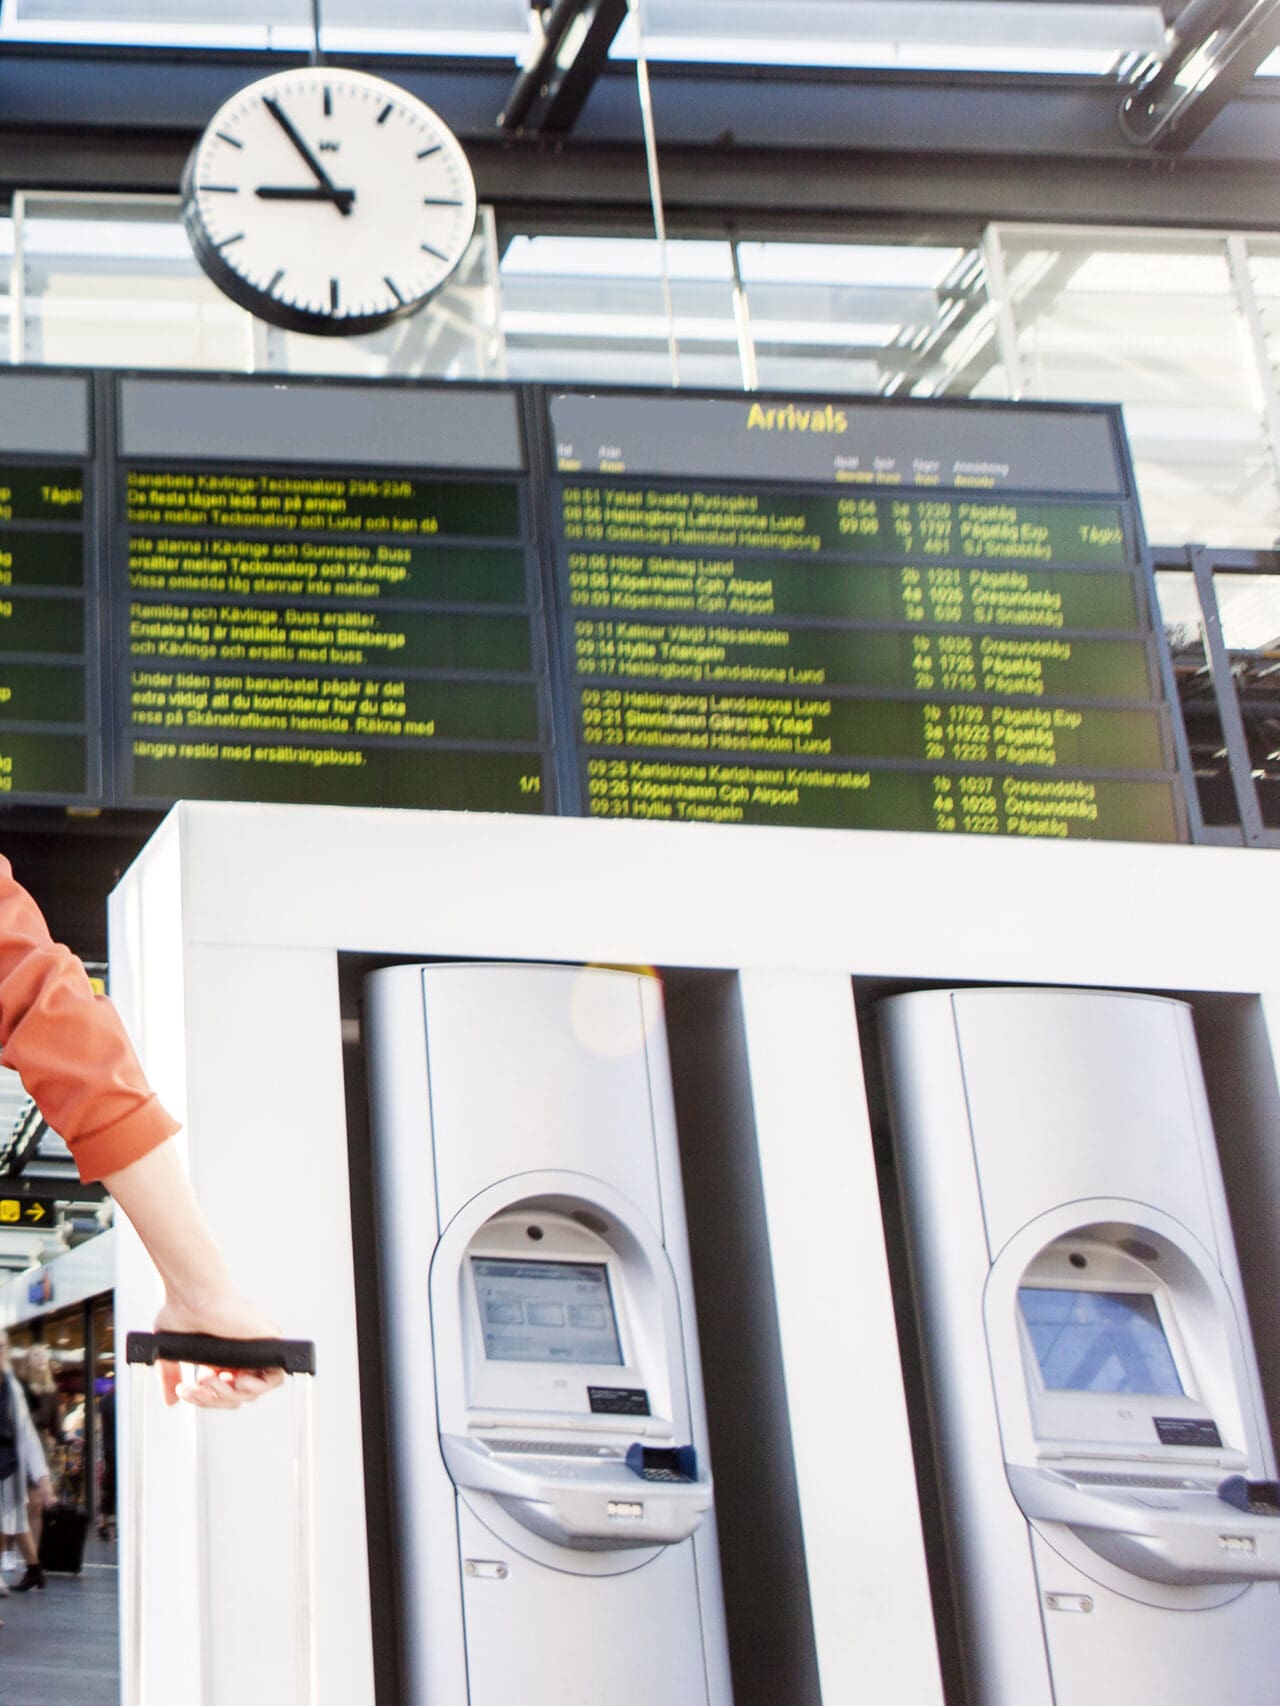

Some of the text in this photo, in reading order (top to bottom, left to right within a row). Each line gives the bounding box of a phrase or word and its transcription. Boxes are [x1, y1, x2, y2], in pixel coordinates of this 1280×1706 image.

[746, 403, 849, 434] Arrivals
[189, 491, 227, 511] tågen
[261, 496, 281, 510] om
[284, 494, 302, 514] på
[305, 498, 347, 512] annan
[165, 509, 208, 526] mellan
[301, 514, 325, 530] och
[328, 515, 362, 532] Lund
[365, 516, 390, 533] och
[393, 517, 418, 534] kan
[769, 513, 1019, 541] Lund Pågatåg
[157, 537, 201, 555] stanna
[213, 540, 270, 561] Kävlinge
[273, 542, 298, 558] och
[377, 546, 412, 563] Buss
[130, 556, 180, 573] ersätter
[183, 557, 227, 575] mellan
[321, 562, 345, 579] och
[698, 559, 1028, 589] Lund Pågatåg
[228, 576, 250, 596] tåg
[254, 577, 305, 594] stannar
[308, 579, 332, 596] inte
[335, 580, 380, 597] mellan
[610, 572, 1062, 608] Köpenhamn Cph Airport Öresundståg
[192, 605, 217, 622] och
[285, 608, 320, 626] Buss
[696, 594, 727, 614] Cph
[728, 596, 775, 616] Airport
[187, 623, 210, 644] tåg
[213, 624, 228, 641] är
[231, 625, 287, 643] inställda
[290, 627, 334, 645] mellan
[337, 629, 406, 650] Billeberga
[980, 637, 1072, 659] Öresundståg
[131, 640, 156, 656] och
[159, 642, 217, 662] Kävlinge
[221, 644, 246, 660] och
[298, 647, 327, 662] med
[618, 640, 1042, 676] Hyllie Triangeln Pågatåg
[132, 672, 406, 699] Under tiden som banarbetet pågår är det
[618, 658, 703, 682] Helsingborg
[788, 665, 826, 684] Lund
[984, 675, 1044, 695] Pågatåg
[132, 689, 407, 716] extra viktigt att du kontrollerar hur du ska
[623, 690, 1083, 730] Helsingborg Landskrona Lund Pågatåg Exp
[133, 711, 163, 725] resa
[166, 710, 183, 730] på
[187, 711, 288, 729] Skånetrafikens
[356, 717, 402, 734] Räkna
[404, 718, 435, 735] med
[772, 715, 814, 735] Ystad
[993, 726, 1055, 746] Pågatåg
[134, 740, 177, 761] längre
[179, 741, 219, 759] restid
[222, 743, 252, 761] med
[794, 734, 832, 754] Lund
[995, 744, 1057, 766] Pågatåg
[520, 774, 541, 793] 1/1
[630, 760, 1096, 799] Karlskrona Karlshamn Kristianstad Öresundståg
[631, 779, 1099, 819] Köpenhamn Cph Airport Öresundståg
[632, 799, 1069, 837] Hyllie Triangeln Pågatåg
